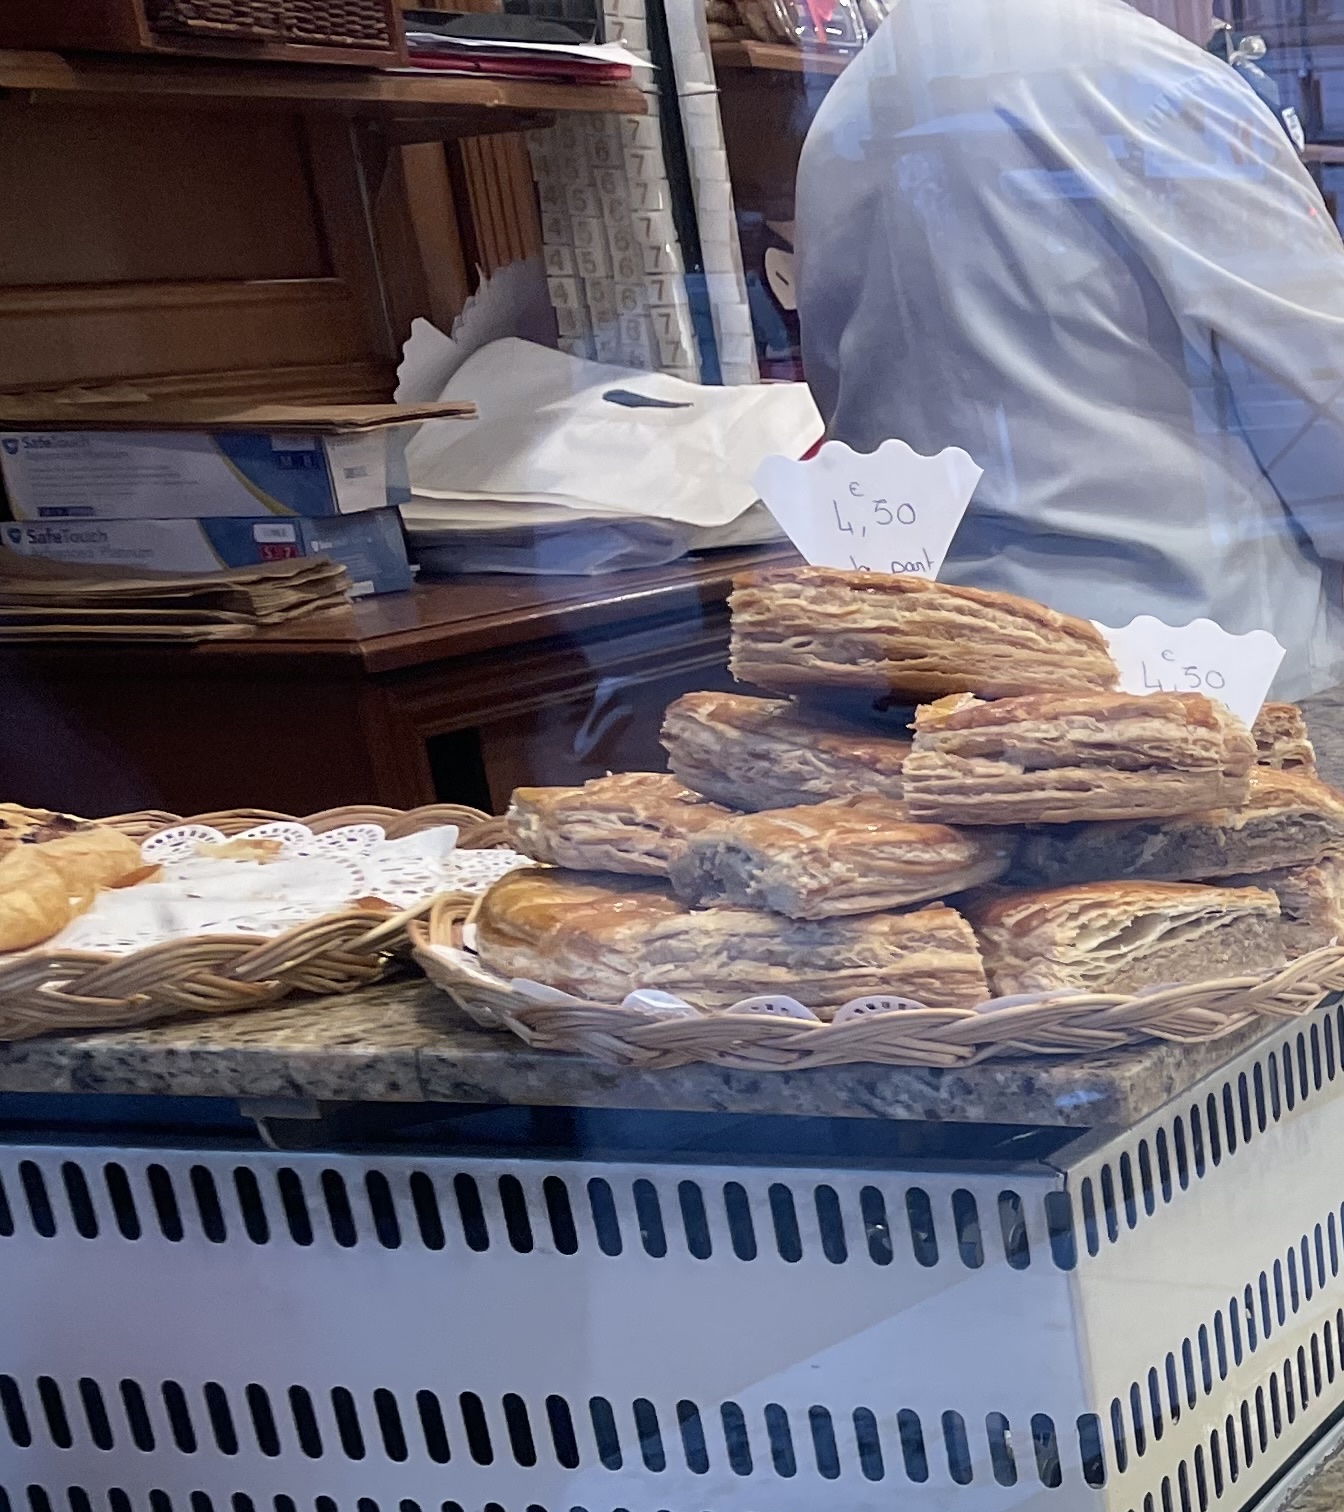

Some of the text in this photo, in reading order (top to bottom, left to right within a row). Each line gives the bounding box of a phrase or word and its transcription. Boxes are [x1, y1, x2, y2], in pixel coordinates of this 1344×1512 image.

[627, 119, 641, 141] 7
[631, 154, 645, 177] 7
[636, 183, 649, 205] 7
[639, 218, 652, 239] 7
[649, 246, 661, 268] 7
[651, 280, 664, 301] 7
[658, 313, 671, 335] 7
[666, 341, 680, 363] 7
[833, 499, 916, 538] 4,50
[27, 527, 108, 544] SafeTouch
[1141, 661, 1226, 693] 4,50
